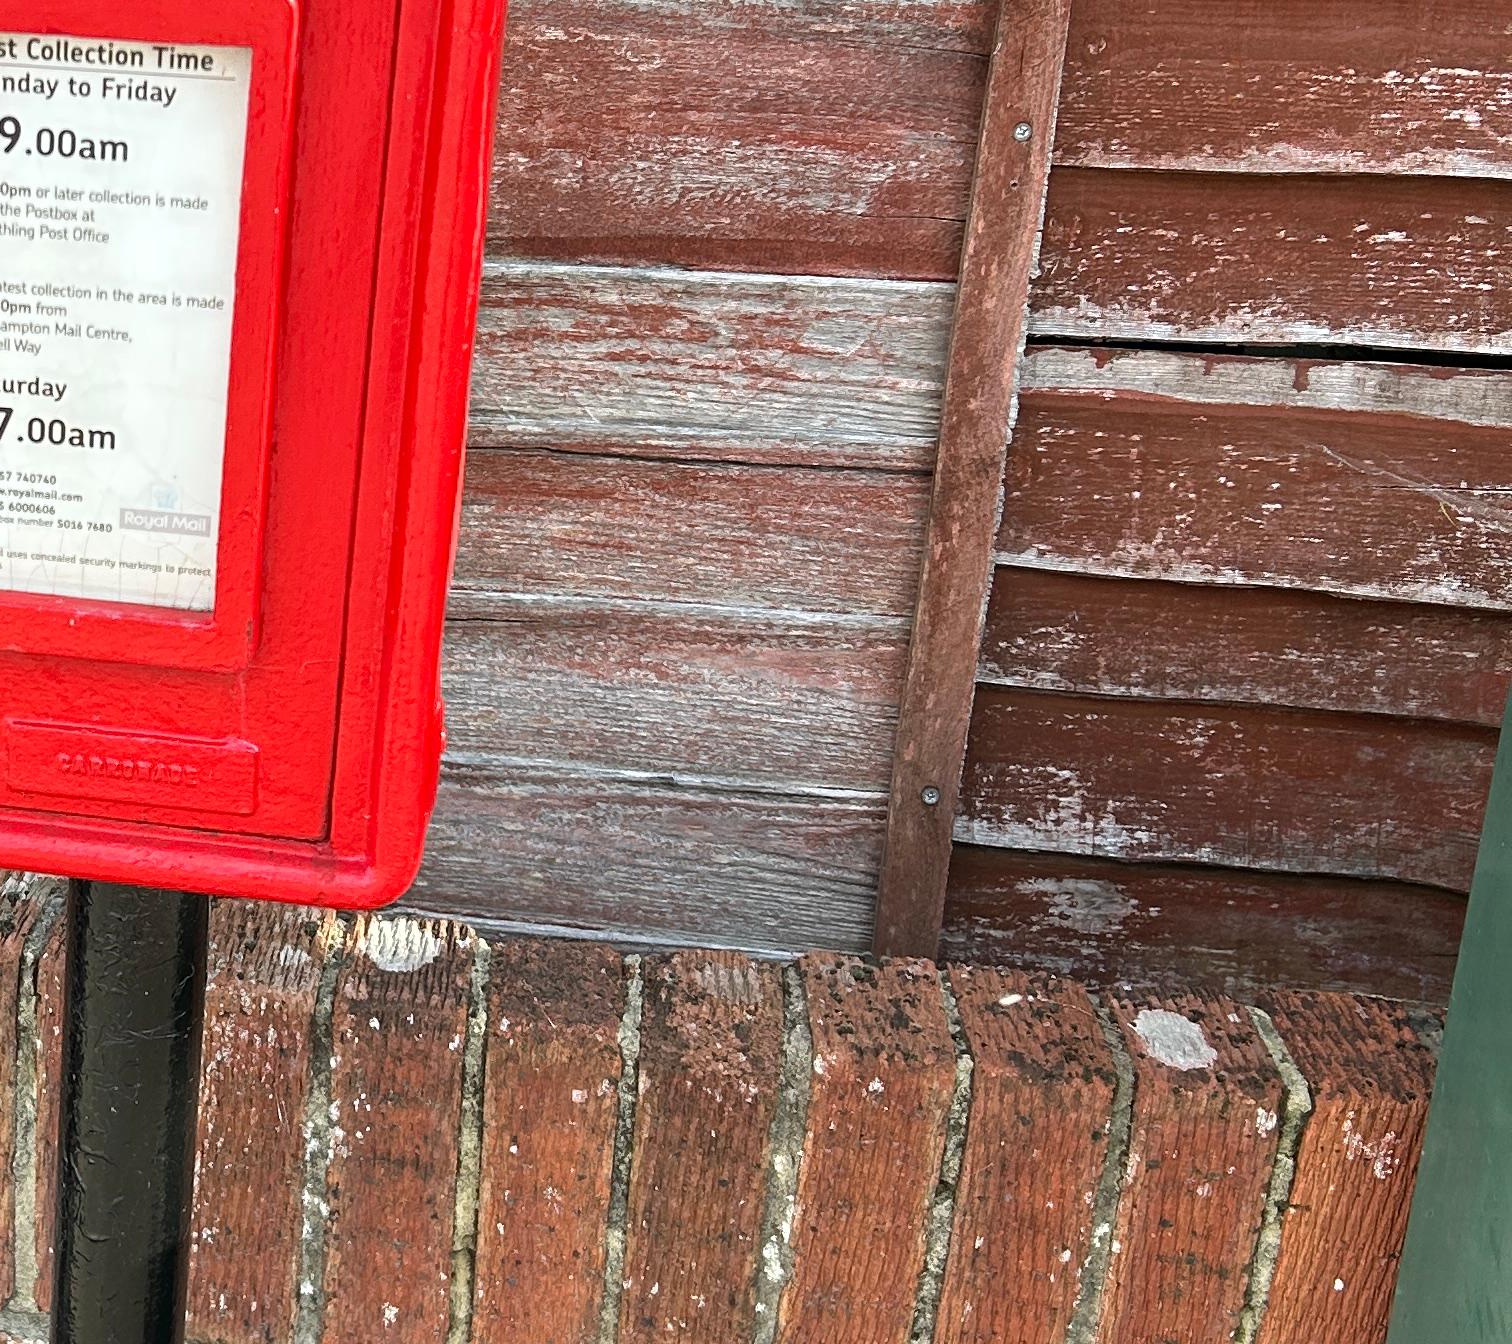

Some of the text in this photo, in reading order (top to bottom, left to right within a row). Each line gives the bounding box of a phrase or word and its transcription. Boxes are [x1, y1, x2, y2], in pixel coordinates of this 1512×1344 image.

[27, 38, 144, 67] Collection
[153, 46, 214, 71] Time
[69, 78, 91, 97] to
[102, 78, 177, 107] Friday
[36, 188, 50, 199] or
[54, 186, 84, 201] later
[89, 190, 151, 206] collection
[156, 193, 165, 207] is
[170, 195, 209, 211] made
[0, 203, 21, 218] the
[26, 205, 77, 222] Postbox
[82, 209, 95, 223] at
[40, 224, 68, 240] Post
[73, 226, 110, 244] Office
[31, 282, 91, 299] collection
[96, 286, 108, 301] in
[113, 287, 134, 303] the
[138, 292, 167, 306] area
[171, 292, 181, 306] is
[186, 293, 224, 310] made
[35, 301, 67, 317] from
[55, 322, 82, 338] Mail
[86, 325, 132, 343] Centre,
[14, 340, 41, 356] Way
[16, 472, 57, 485] 740740
[18, 516, 54, 527] number
[124, 511, 207, 532] Royal Mail
